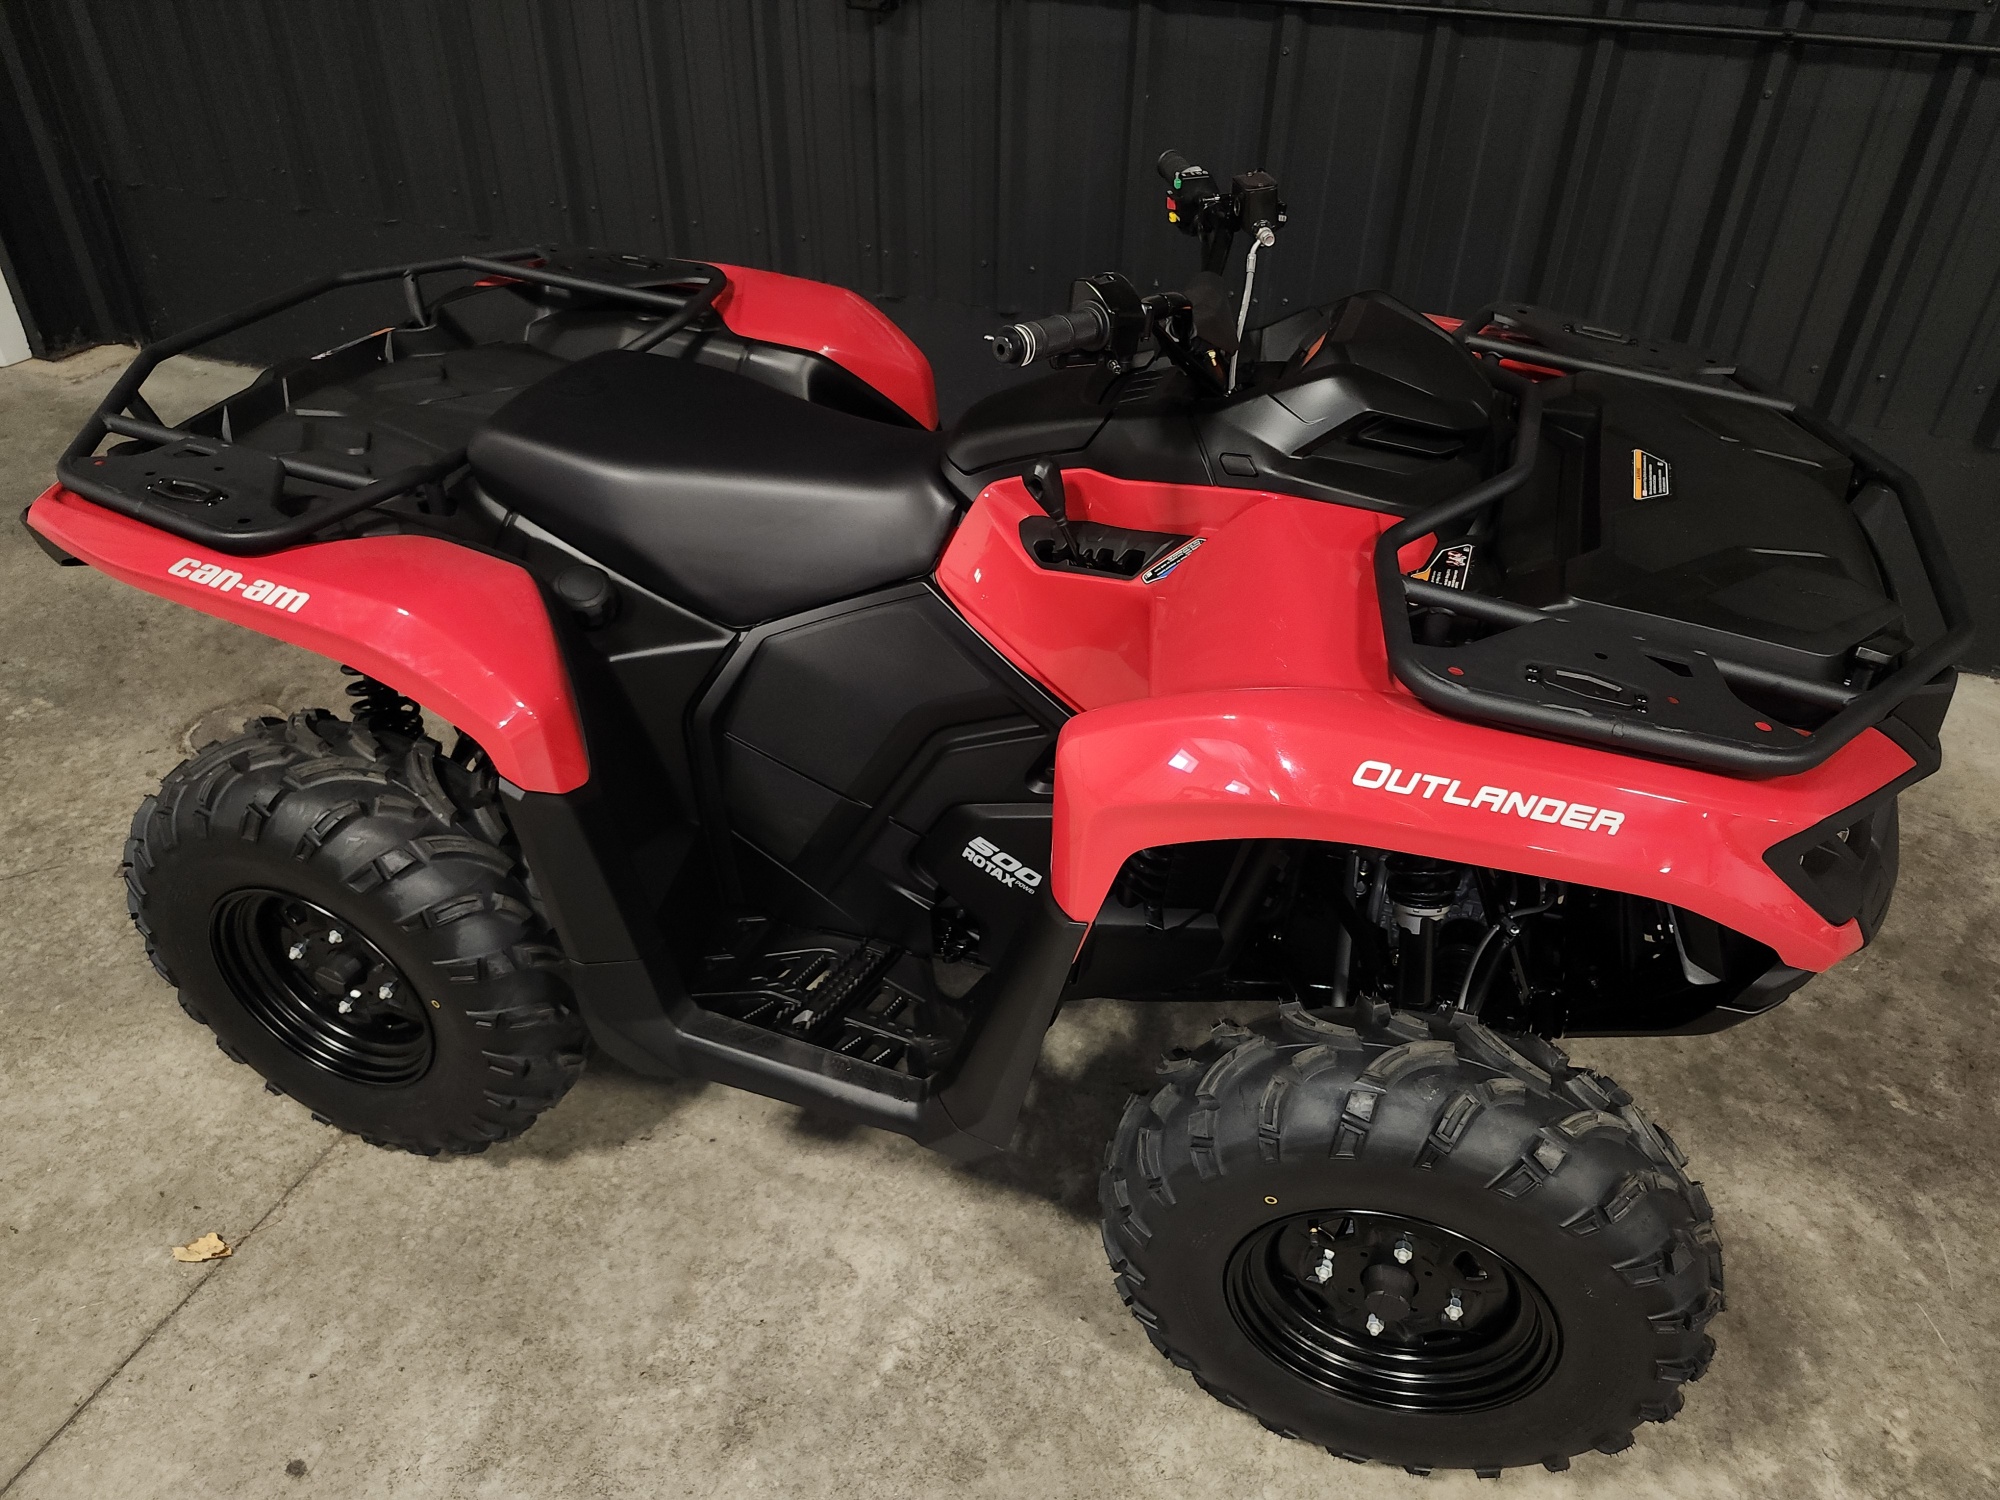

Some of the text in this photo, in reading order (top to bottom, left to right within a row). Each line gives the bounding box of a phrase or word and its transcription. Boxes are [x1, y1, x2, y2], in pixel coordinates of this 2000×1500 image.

[167, 557, 311, 614] can-am
[1352, 760, 1626, 836] OUTLANDER
[961, 846, 1017, 888] ROTAX
[967, 835, 1043, 887] 500
